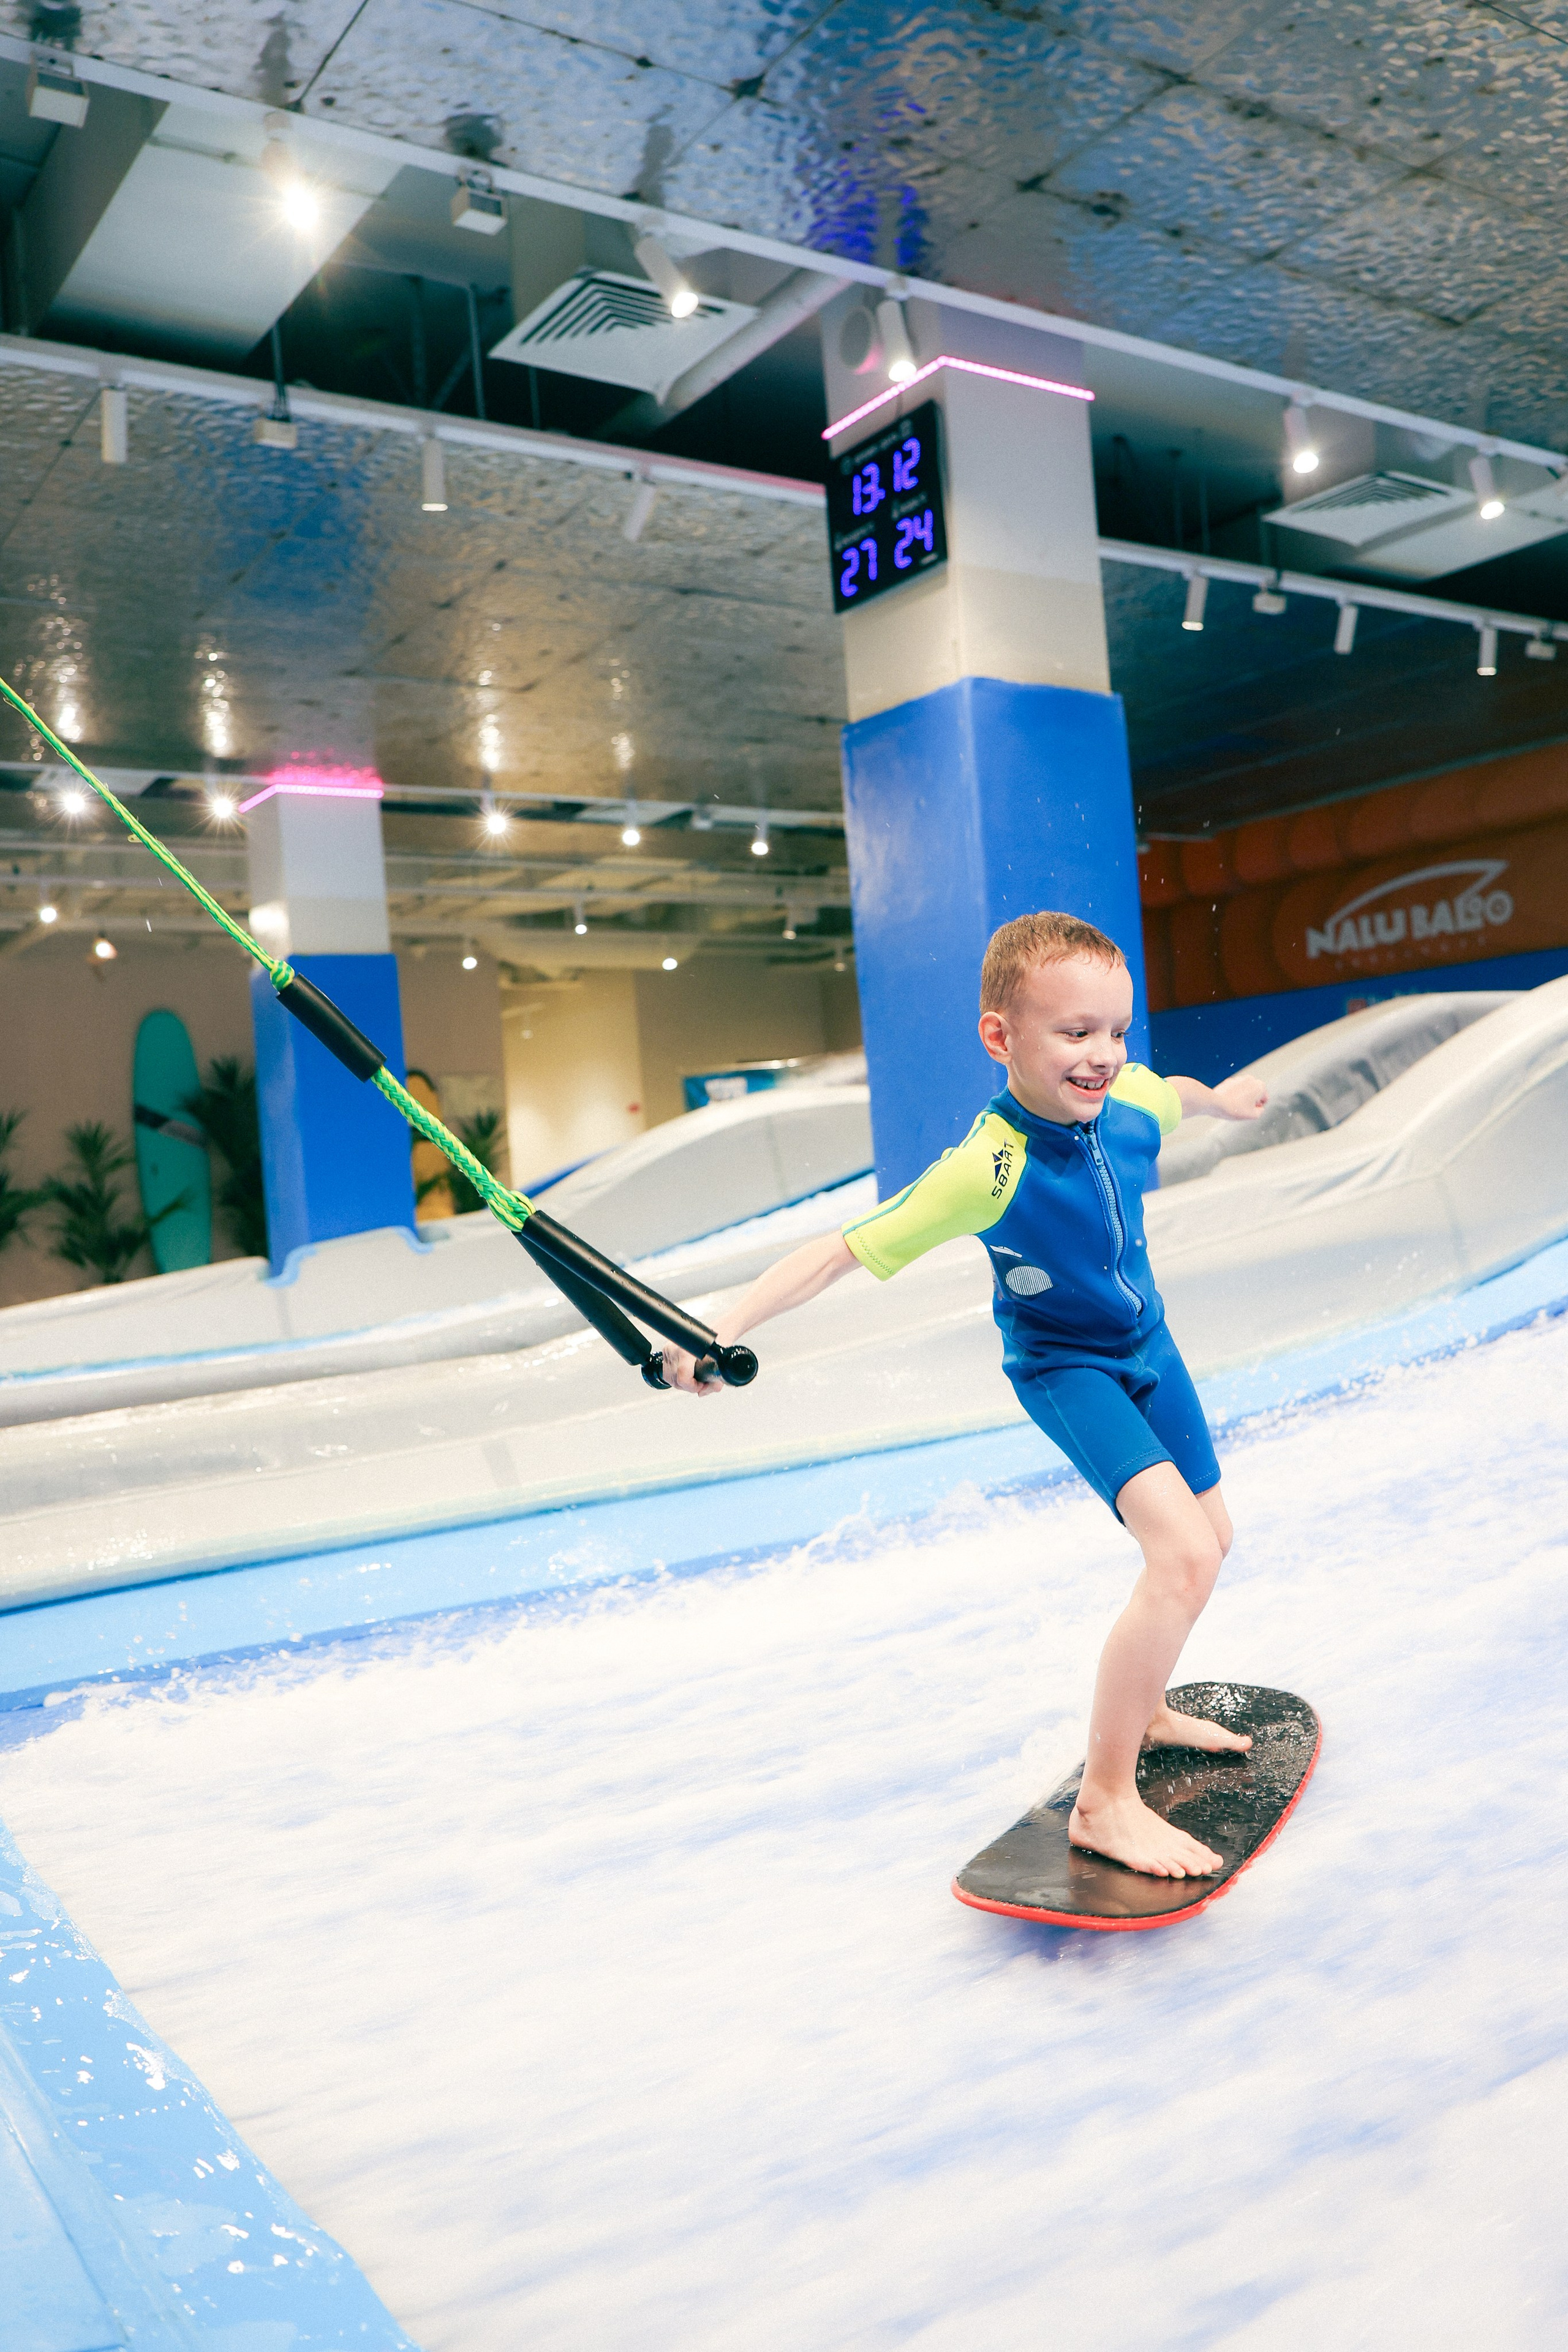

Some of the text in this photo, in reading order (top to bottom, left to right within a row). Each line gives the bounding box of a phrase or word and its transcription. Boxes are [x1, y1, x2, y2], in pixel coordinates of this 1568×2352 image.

[840, 537, 878, 598] 27
[894, 508, 933, 569] 24
[1306, 908, 1407, 960] NALU
